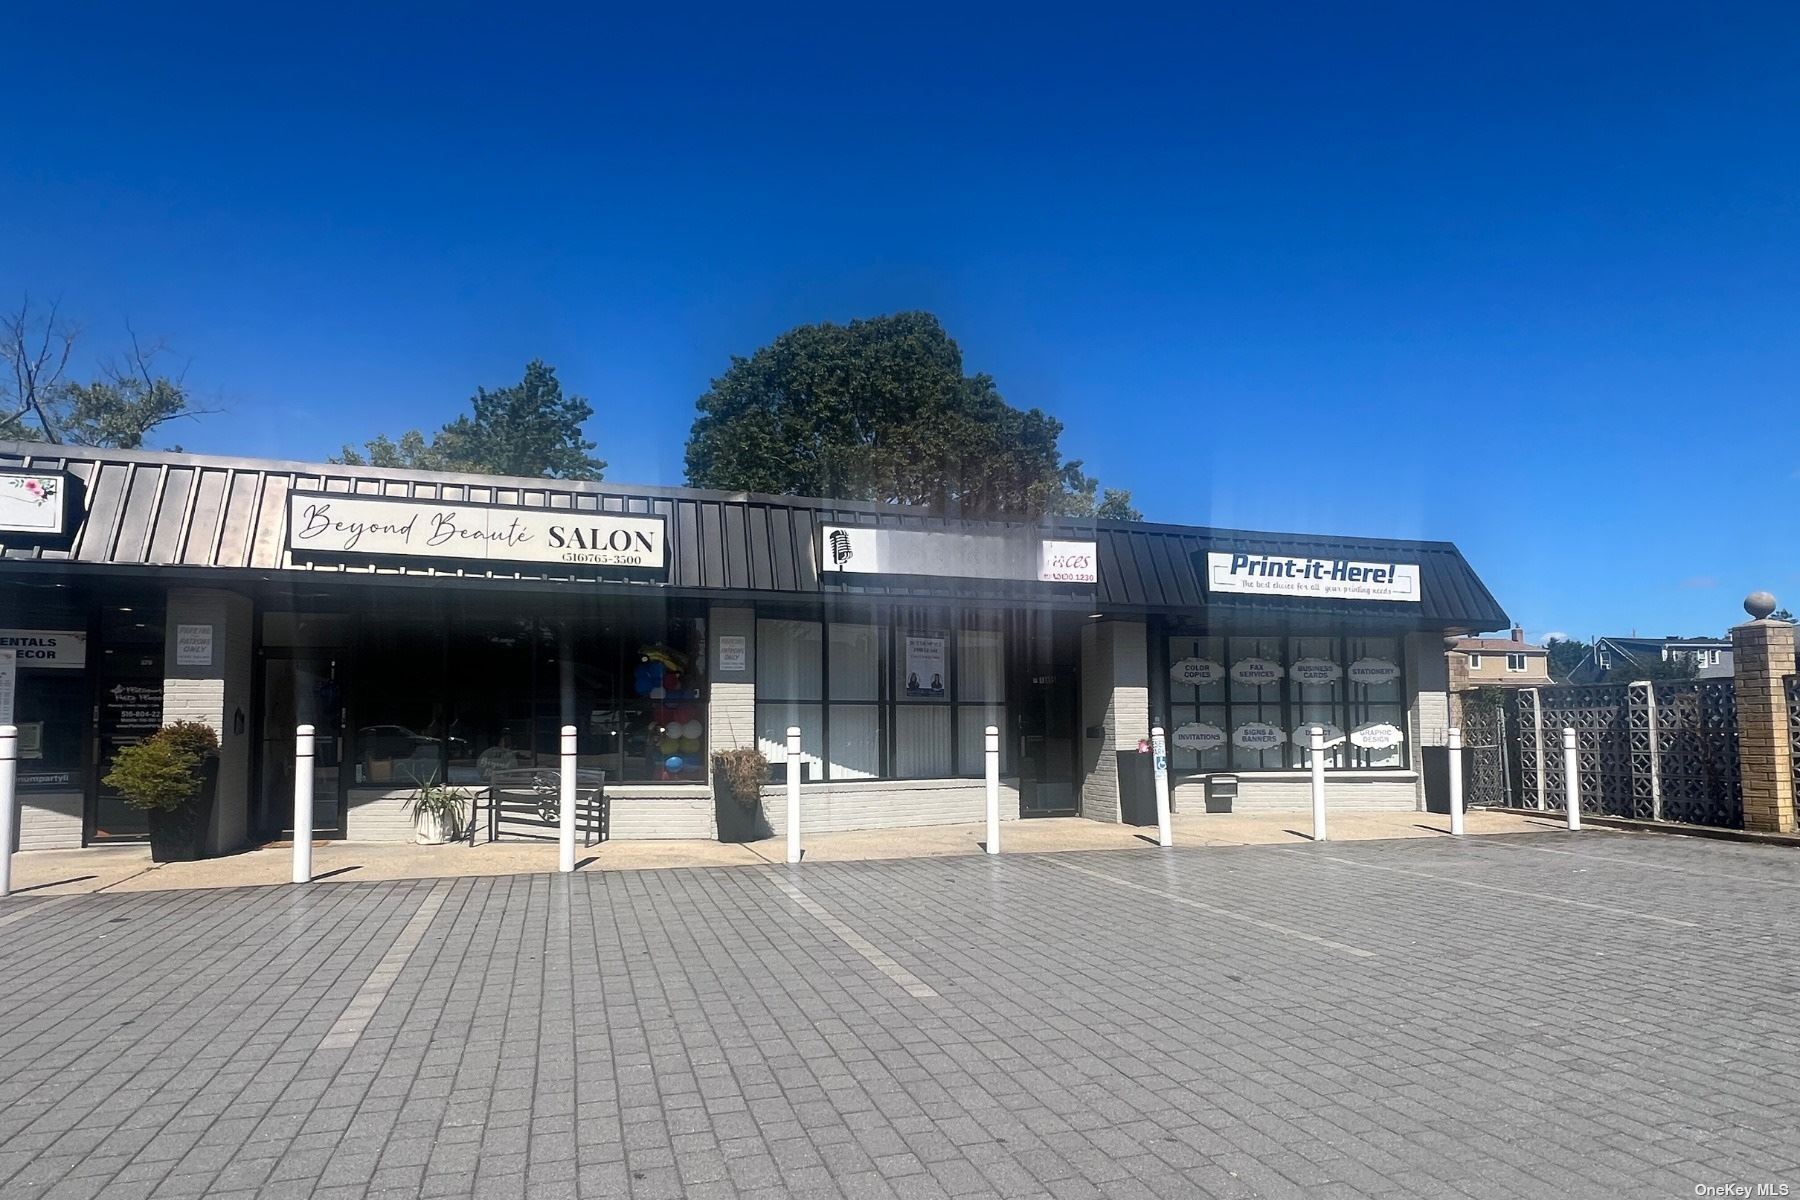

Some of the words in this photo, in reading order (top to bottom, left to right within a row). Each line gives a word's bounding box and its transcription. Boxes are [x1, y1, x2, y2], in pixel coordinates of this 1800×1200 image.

[298, 504, 418, 550] Beyond
[426, 508, 534, 547] Beauté
[548, 525, 654, 553] SALON
[562, 552, 642, 565] (516)765-3500
[1230, 553, 1396, 584] Print-it-Here!
[1242, 580, 1254, 588] The
[1256, 580, 1271, 589] best
[1273, 582, 1294, 590] choice
[1296, 582, 1308, 591] for
[1310, 583, 1320, 591] all
[1325, 586, 1341, 594] your
[1343, 586, 1371, 595] printing
[1372, 587, 1392, 595] needs
[0, 637, 56, 647] ENTALS
[16, 649, 56, 659] ECOR
[1184, 664, 1210, 672] COLOR
[1184, 671, 1211, 679] COPIES
[1303, 671, 1329, 679] CARDS
[1178, 733, 1220, 741] INVITATIONS
[1242, 735, 1277, 743] BANNERS
[17, 774, 69, 784] numpartyli
